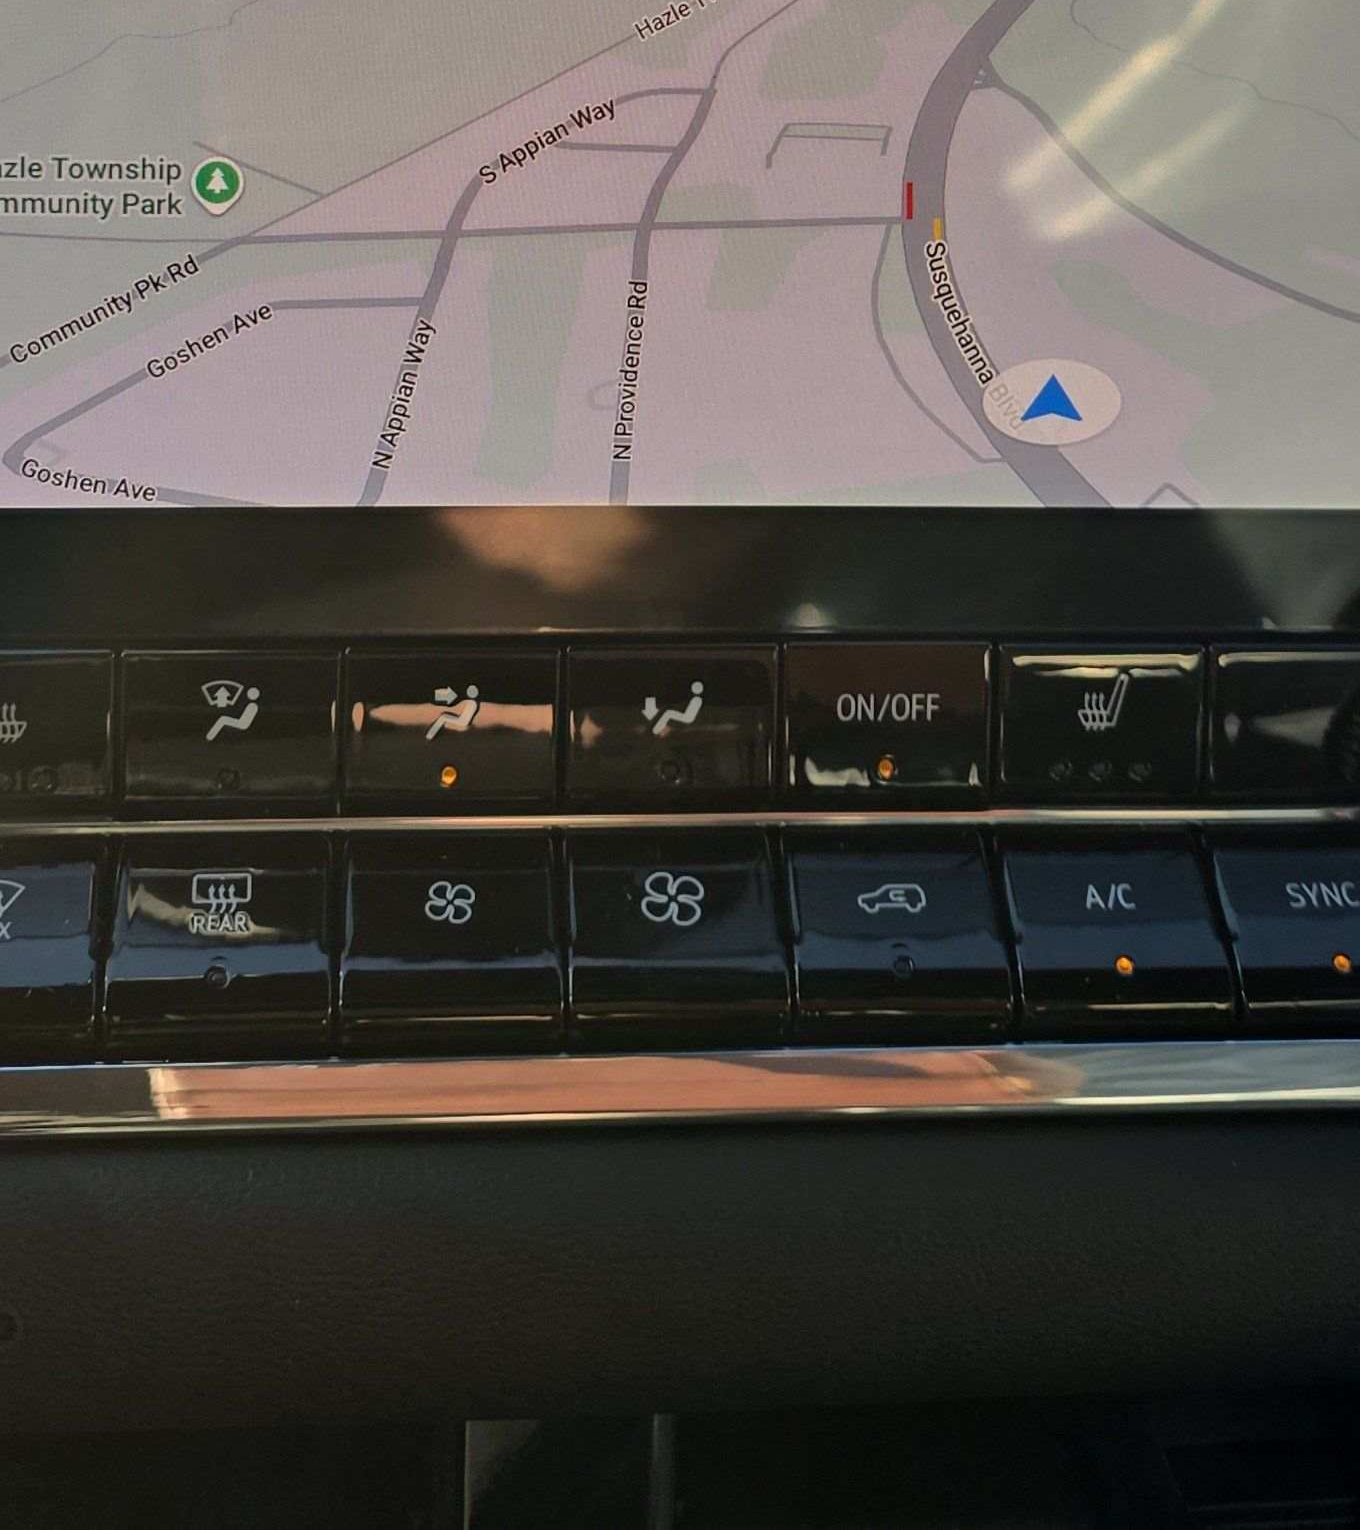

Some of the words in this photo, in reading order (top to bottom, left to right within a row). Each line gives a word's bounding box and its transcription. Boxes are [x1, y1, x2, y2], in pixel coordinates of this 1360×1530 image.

[636, 1, 691, 40] Hazle
[479, 166, 497, 185] S
[498, 122, 570, 175] Appian
[570, 99, 616, 130] Way
[51, 156, 182, 186] Township
[121, 192, 182, 215] Park
[10, 289, 132, 364] Community
[134, 273, 168, 301] Pk
[166, 255, 199, 285] Rd
[626, 280, 649, 309] Rd
[926, 241, 994, 385] Susquehanna
[146, 325, 229, 379] Goshen
[233, 304, 273, 336] Ave
[403, 319, 437, 365] Way
[614, 313, 645, 436] Providence
[380, 370, 419, 447] Appian
[372, 447, 393, 469] N
[614, 444, 633, 460] N
[21, 459, 108, 494] Goshen
[113, 477, 158, 502] Ave
[836, 693, 940, 723] ON/OFF
[1086, 884, 1136, 911] A/C
[192, 913, 249, 933] REAR
